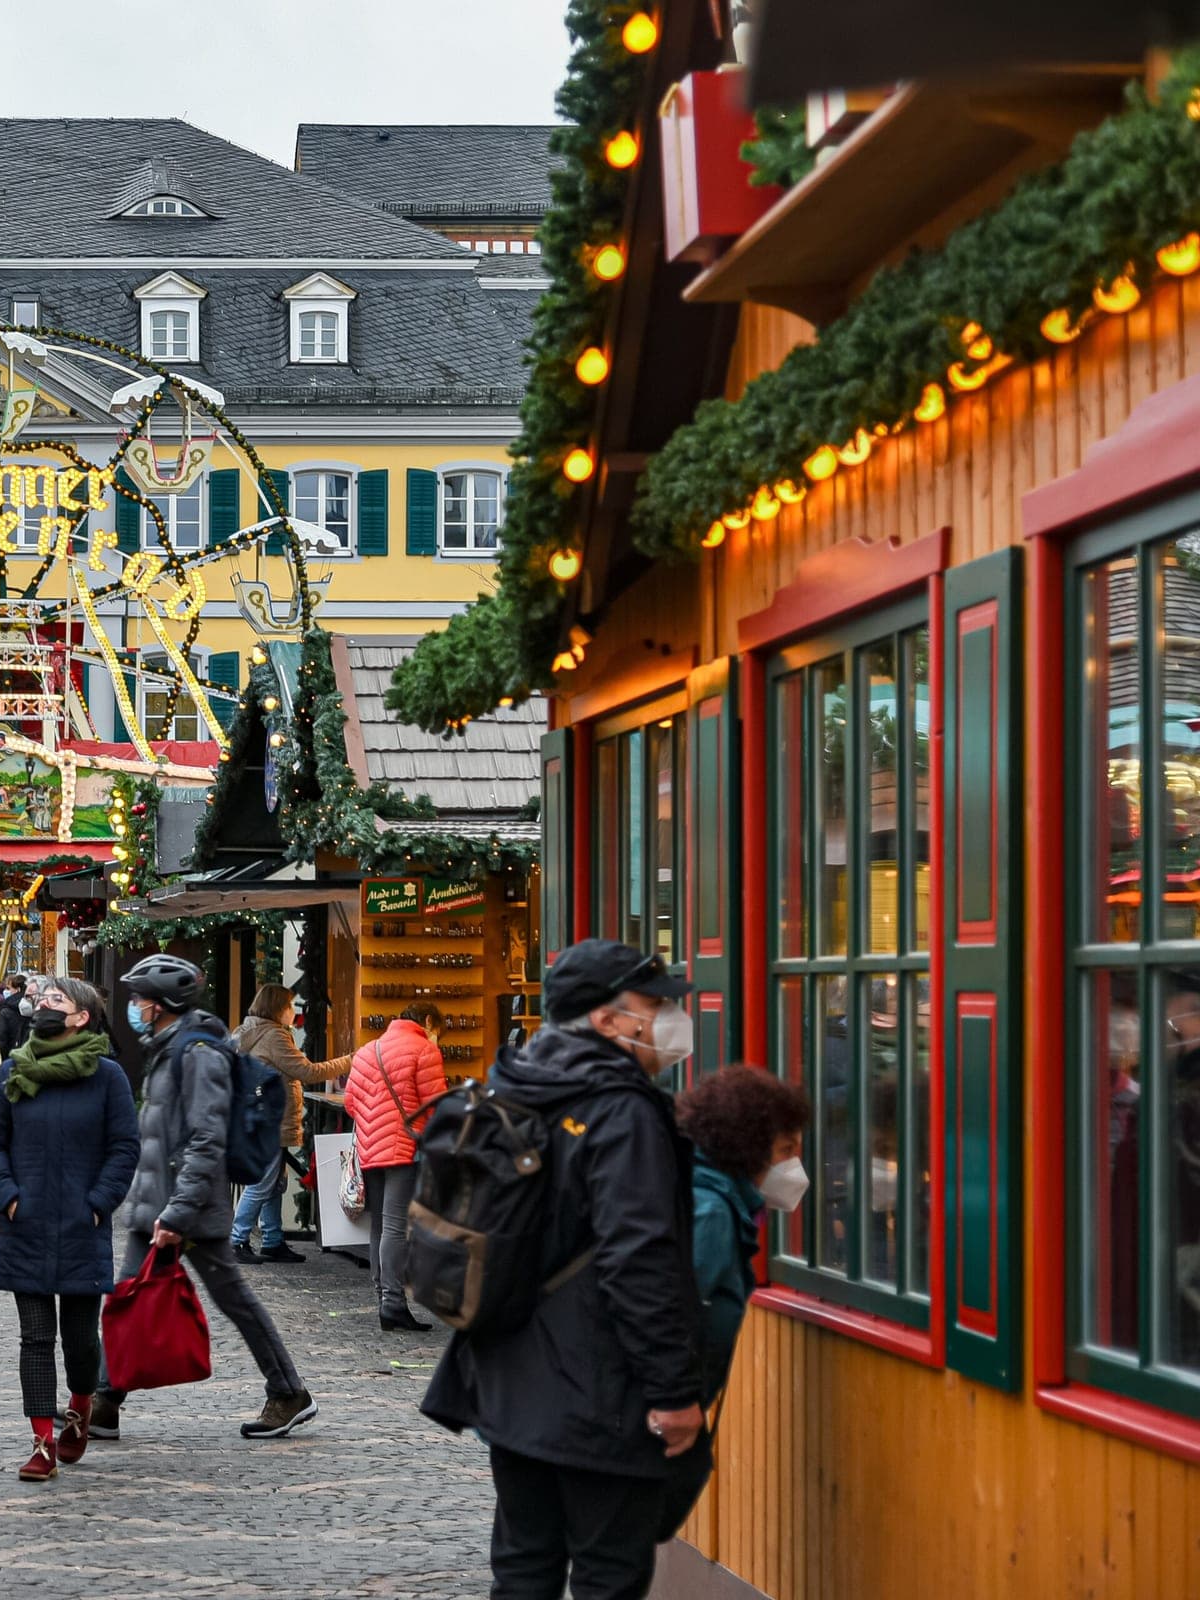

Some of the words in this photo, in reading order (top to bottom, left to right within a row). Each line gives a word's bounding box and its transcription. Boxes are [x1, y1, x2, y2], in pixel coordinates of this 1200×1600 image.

[367, 888, 390, 904] Made
[391, 888, 400, 897] in
[427, 881, 478, 905] Armbänder
[377, 897, 417, 912] Bavaria
